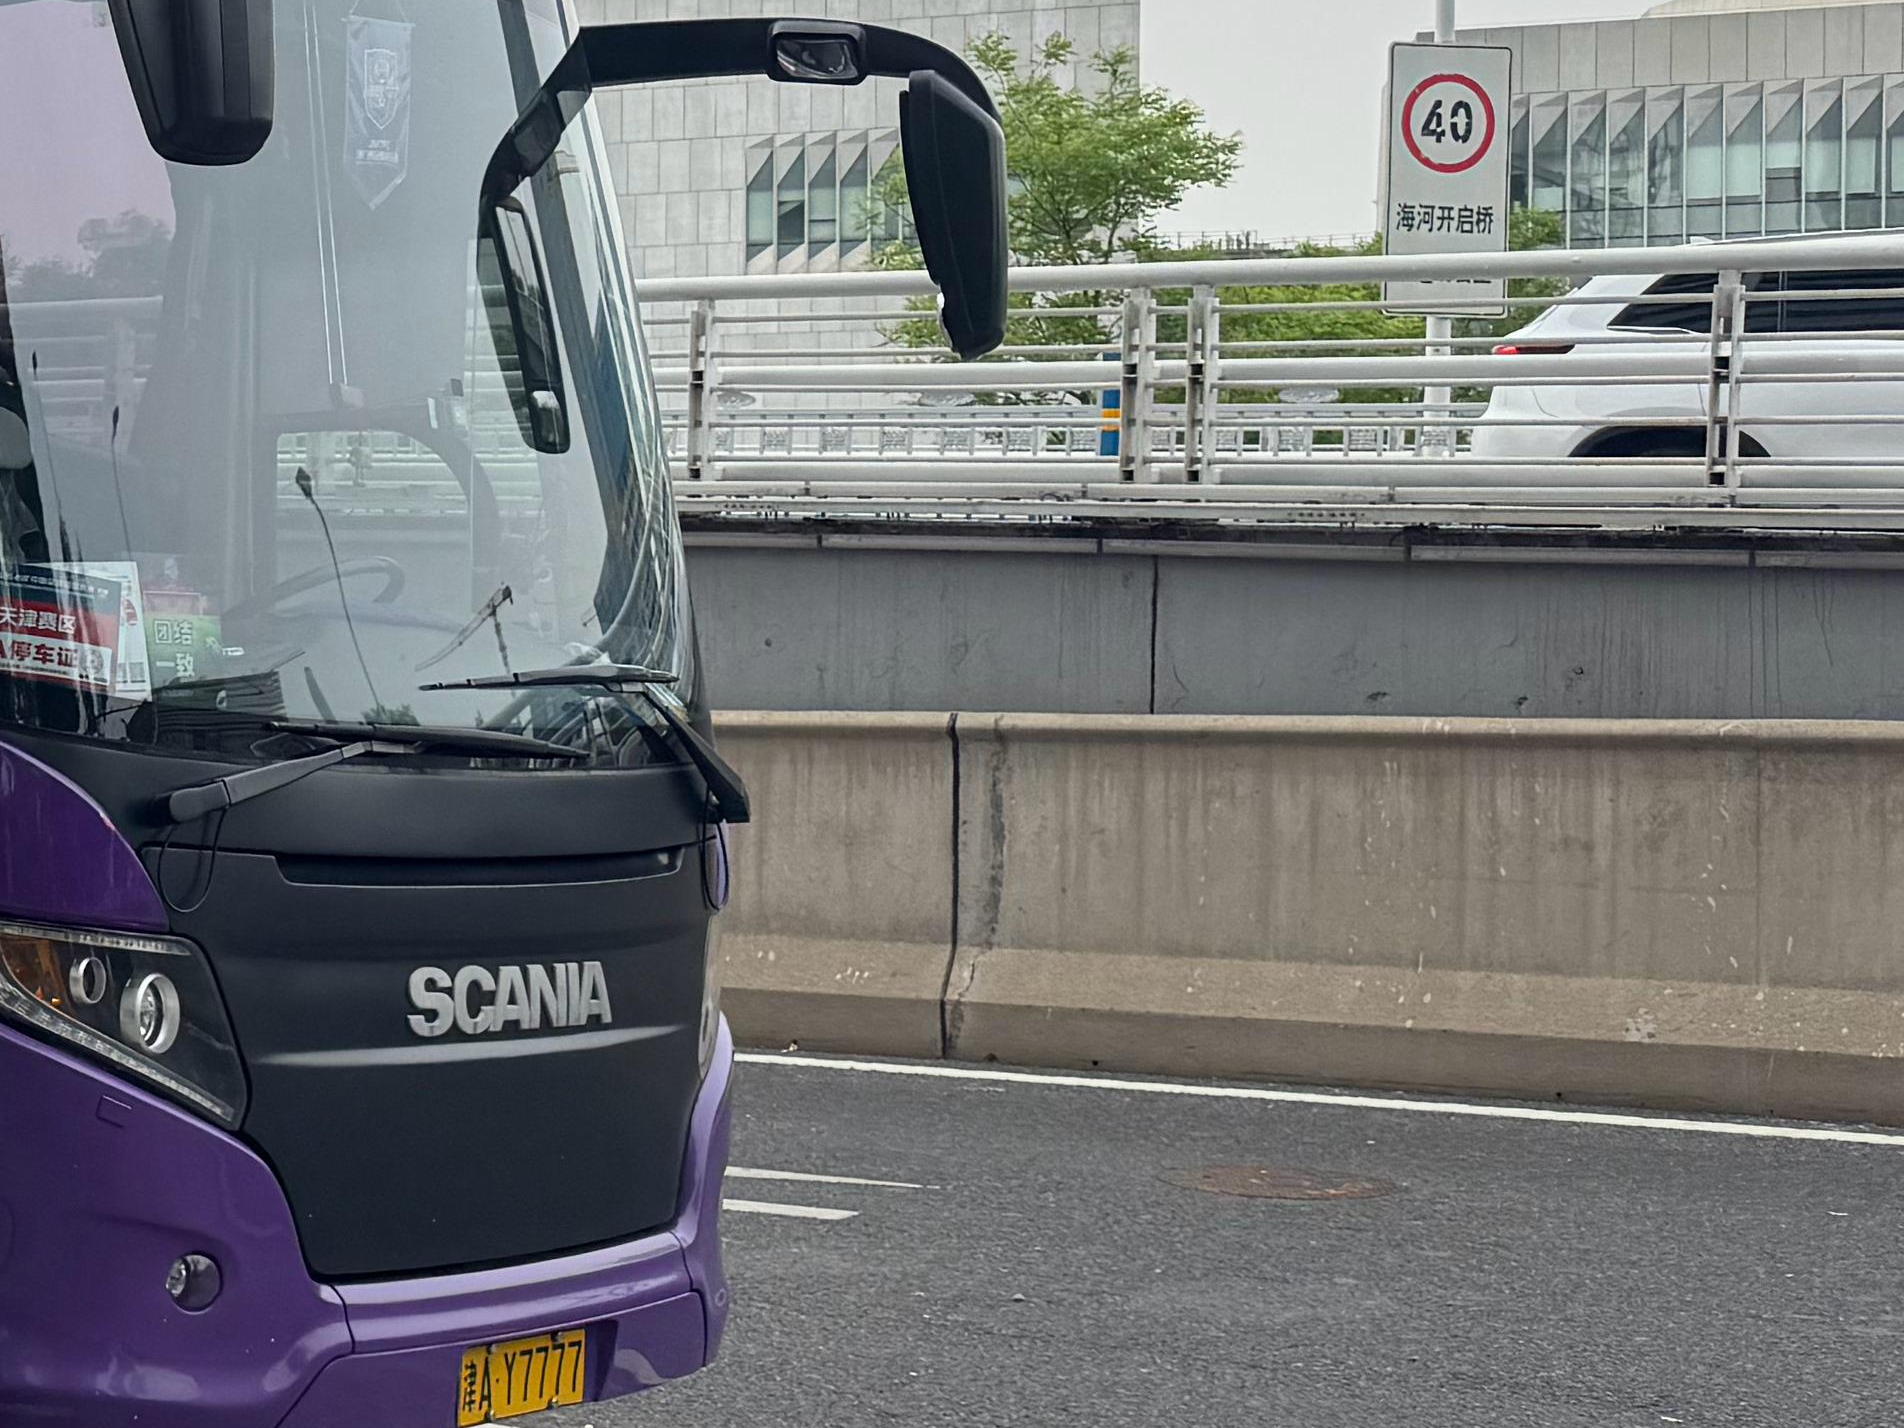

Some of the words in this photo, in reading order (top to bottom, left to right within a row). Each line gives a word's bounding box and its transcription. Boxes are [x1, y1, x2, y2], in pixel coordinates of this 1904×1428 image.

[1421, 100, 1473, 143] 40
[1396, 202, 1494, 234] 海河开启桥
[154, 619, 193, 645] 团结
[155, 652, 195, 678] 一致
[407, 960, 613, 1038] SCANIA
